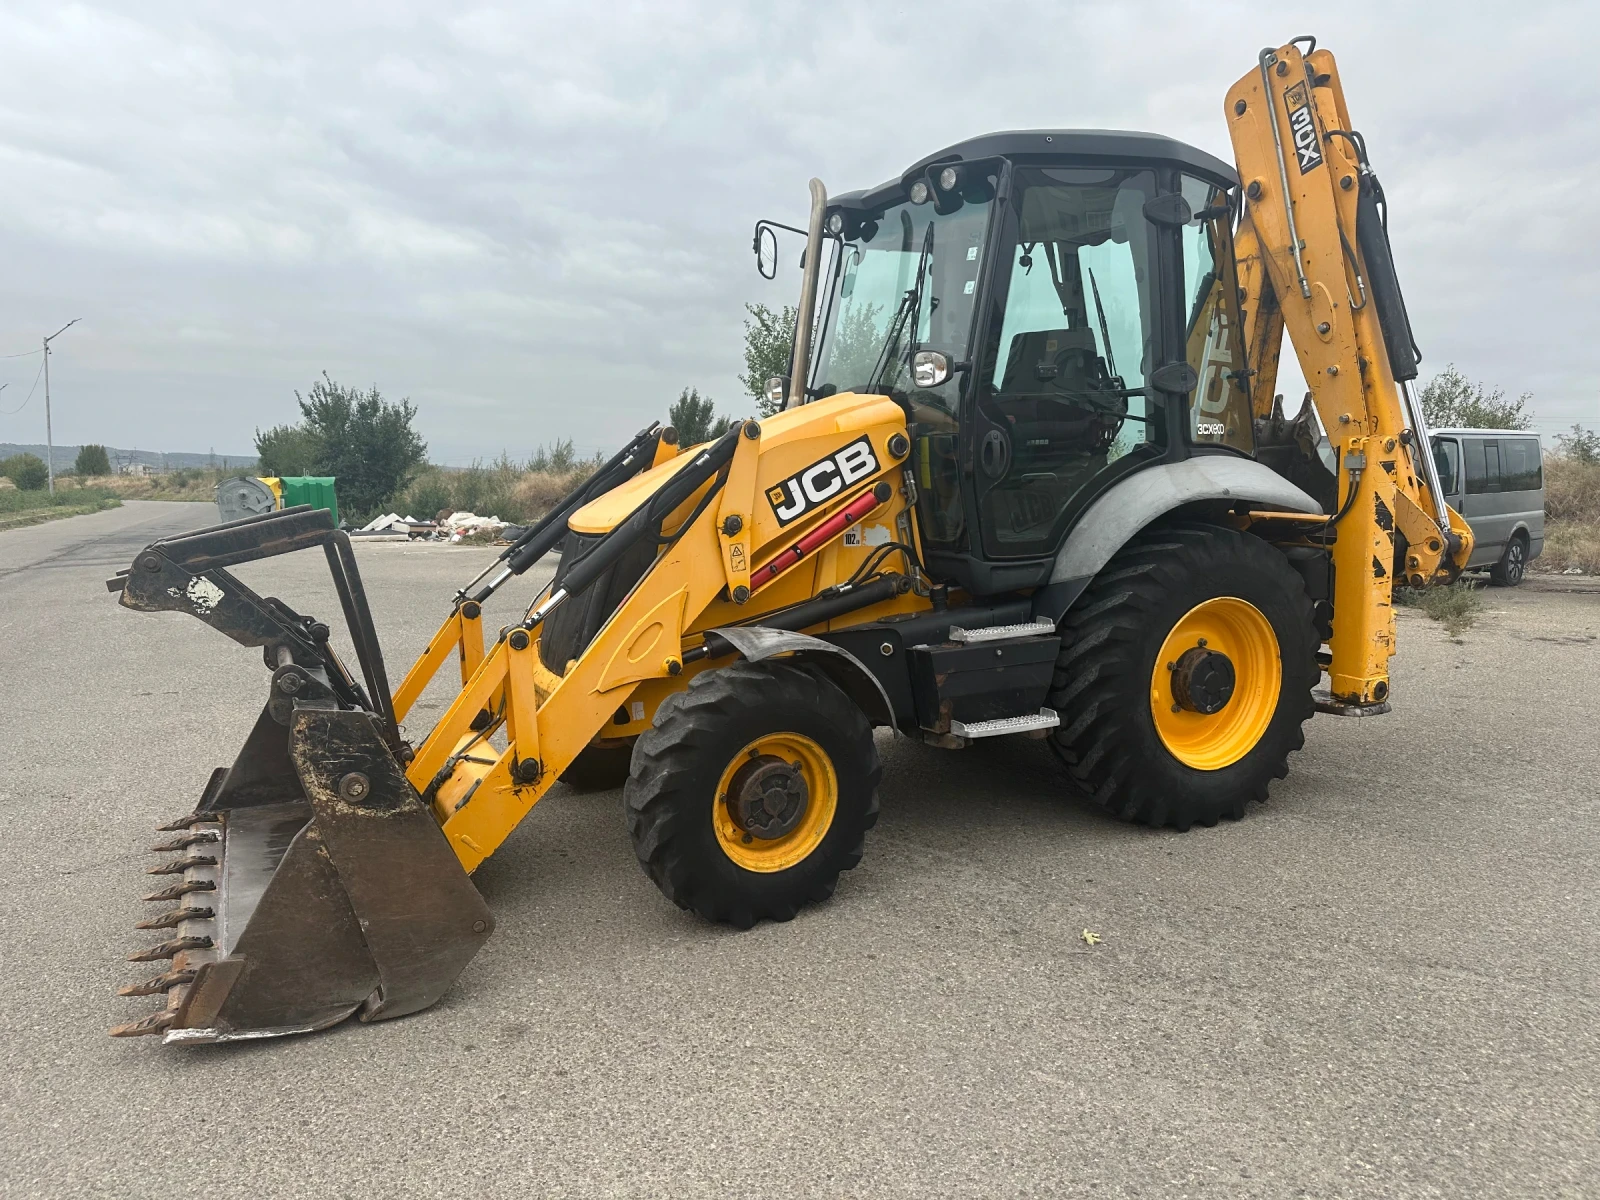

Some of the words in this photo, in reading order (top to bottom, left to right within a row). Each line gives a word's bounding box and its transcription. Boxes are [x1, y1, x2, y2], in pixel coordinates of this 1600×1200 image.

[1291, 106, 1321, 167] 3CX
[776, 441, 877, 521] JCB
[845, 533, 856, 545] 102
